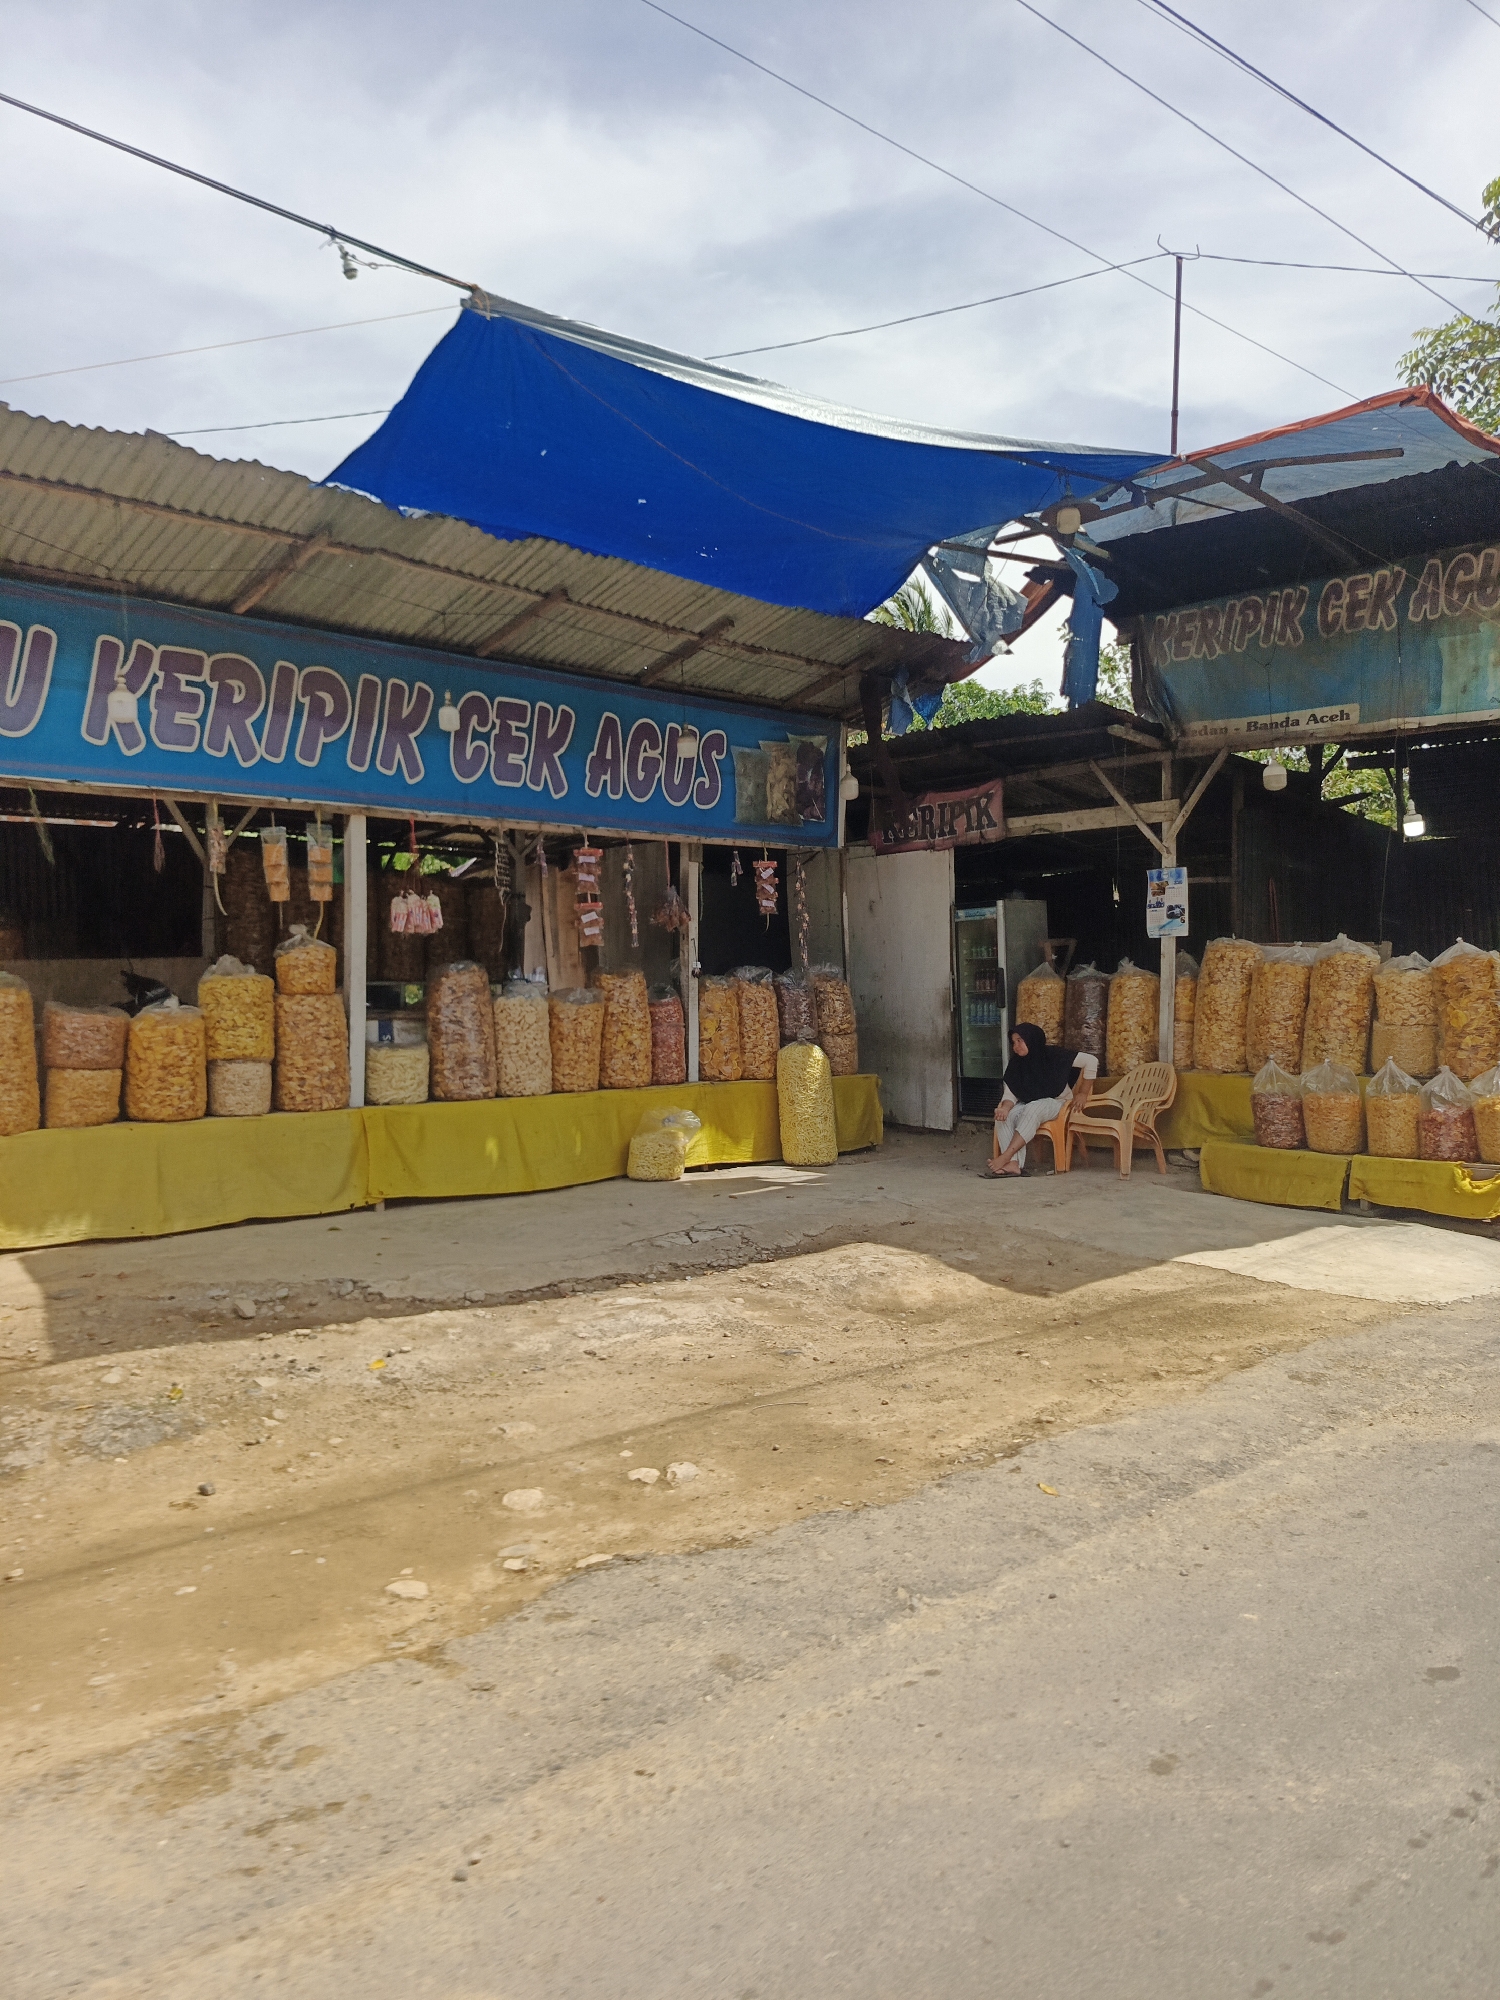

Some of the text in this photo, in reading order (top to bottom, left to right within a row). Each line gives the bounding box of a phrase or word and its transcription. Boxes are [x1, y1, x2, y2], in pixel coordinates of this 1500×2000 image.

[1151, 585, 1308, 668] KERIPIK
[1317, 565, 1405, 638] CEK
[81, 634, 434, 784] KERIPIK
[449, 690, 575, 799] CEK
[585, 711, 727, 809] AGUS
[1246, 716, 1300, 733] Banda
[1305, 709, 1350, 726] Aceh
[881, 790, 998, 844] KERIPIK
